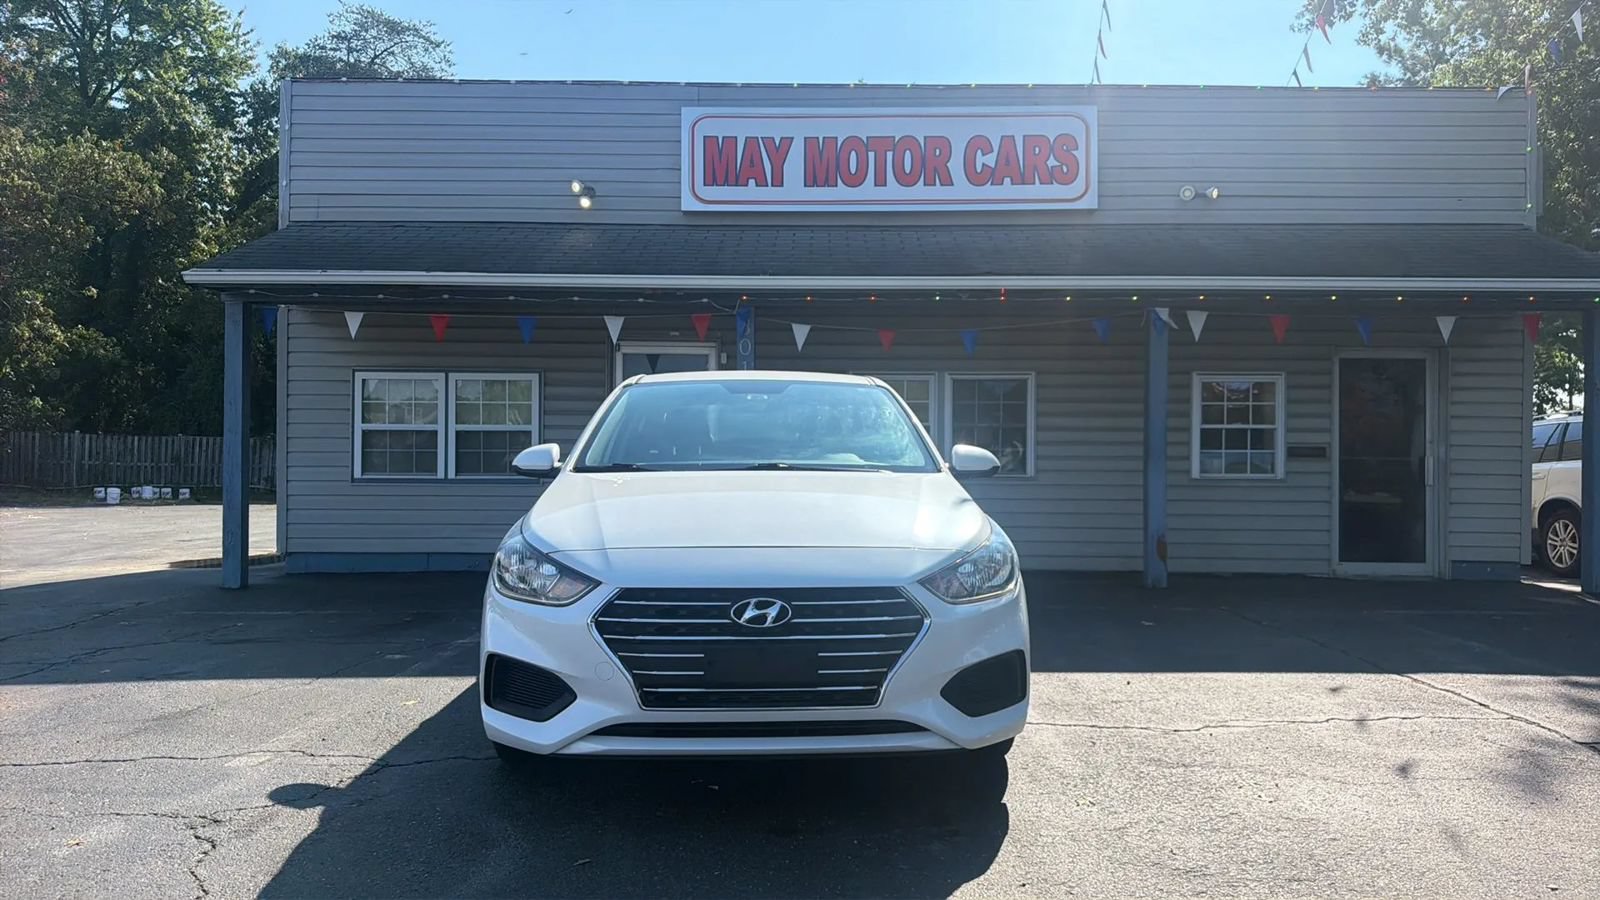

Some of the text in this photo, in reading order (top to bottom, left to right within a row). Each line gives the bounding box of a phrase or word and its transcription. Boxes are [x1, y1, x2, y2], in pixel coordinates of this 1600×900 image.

[703, 134, 1080, 189] MAY MOTOR CARS
